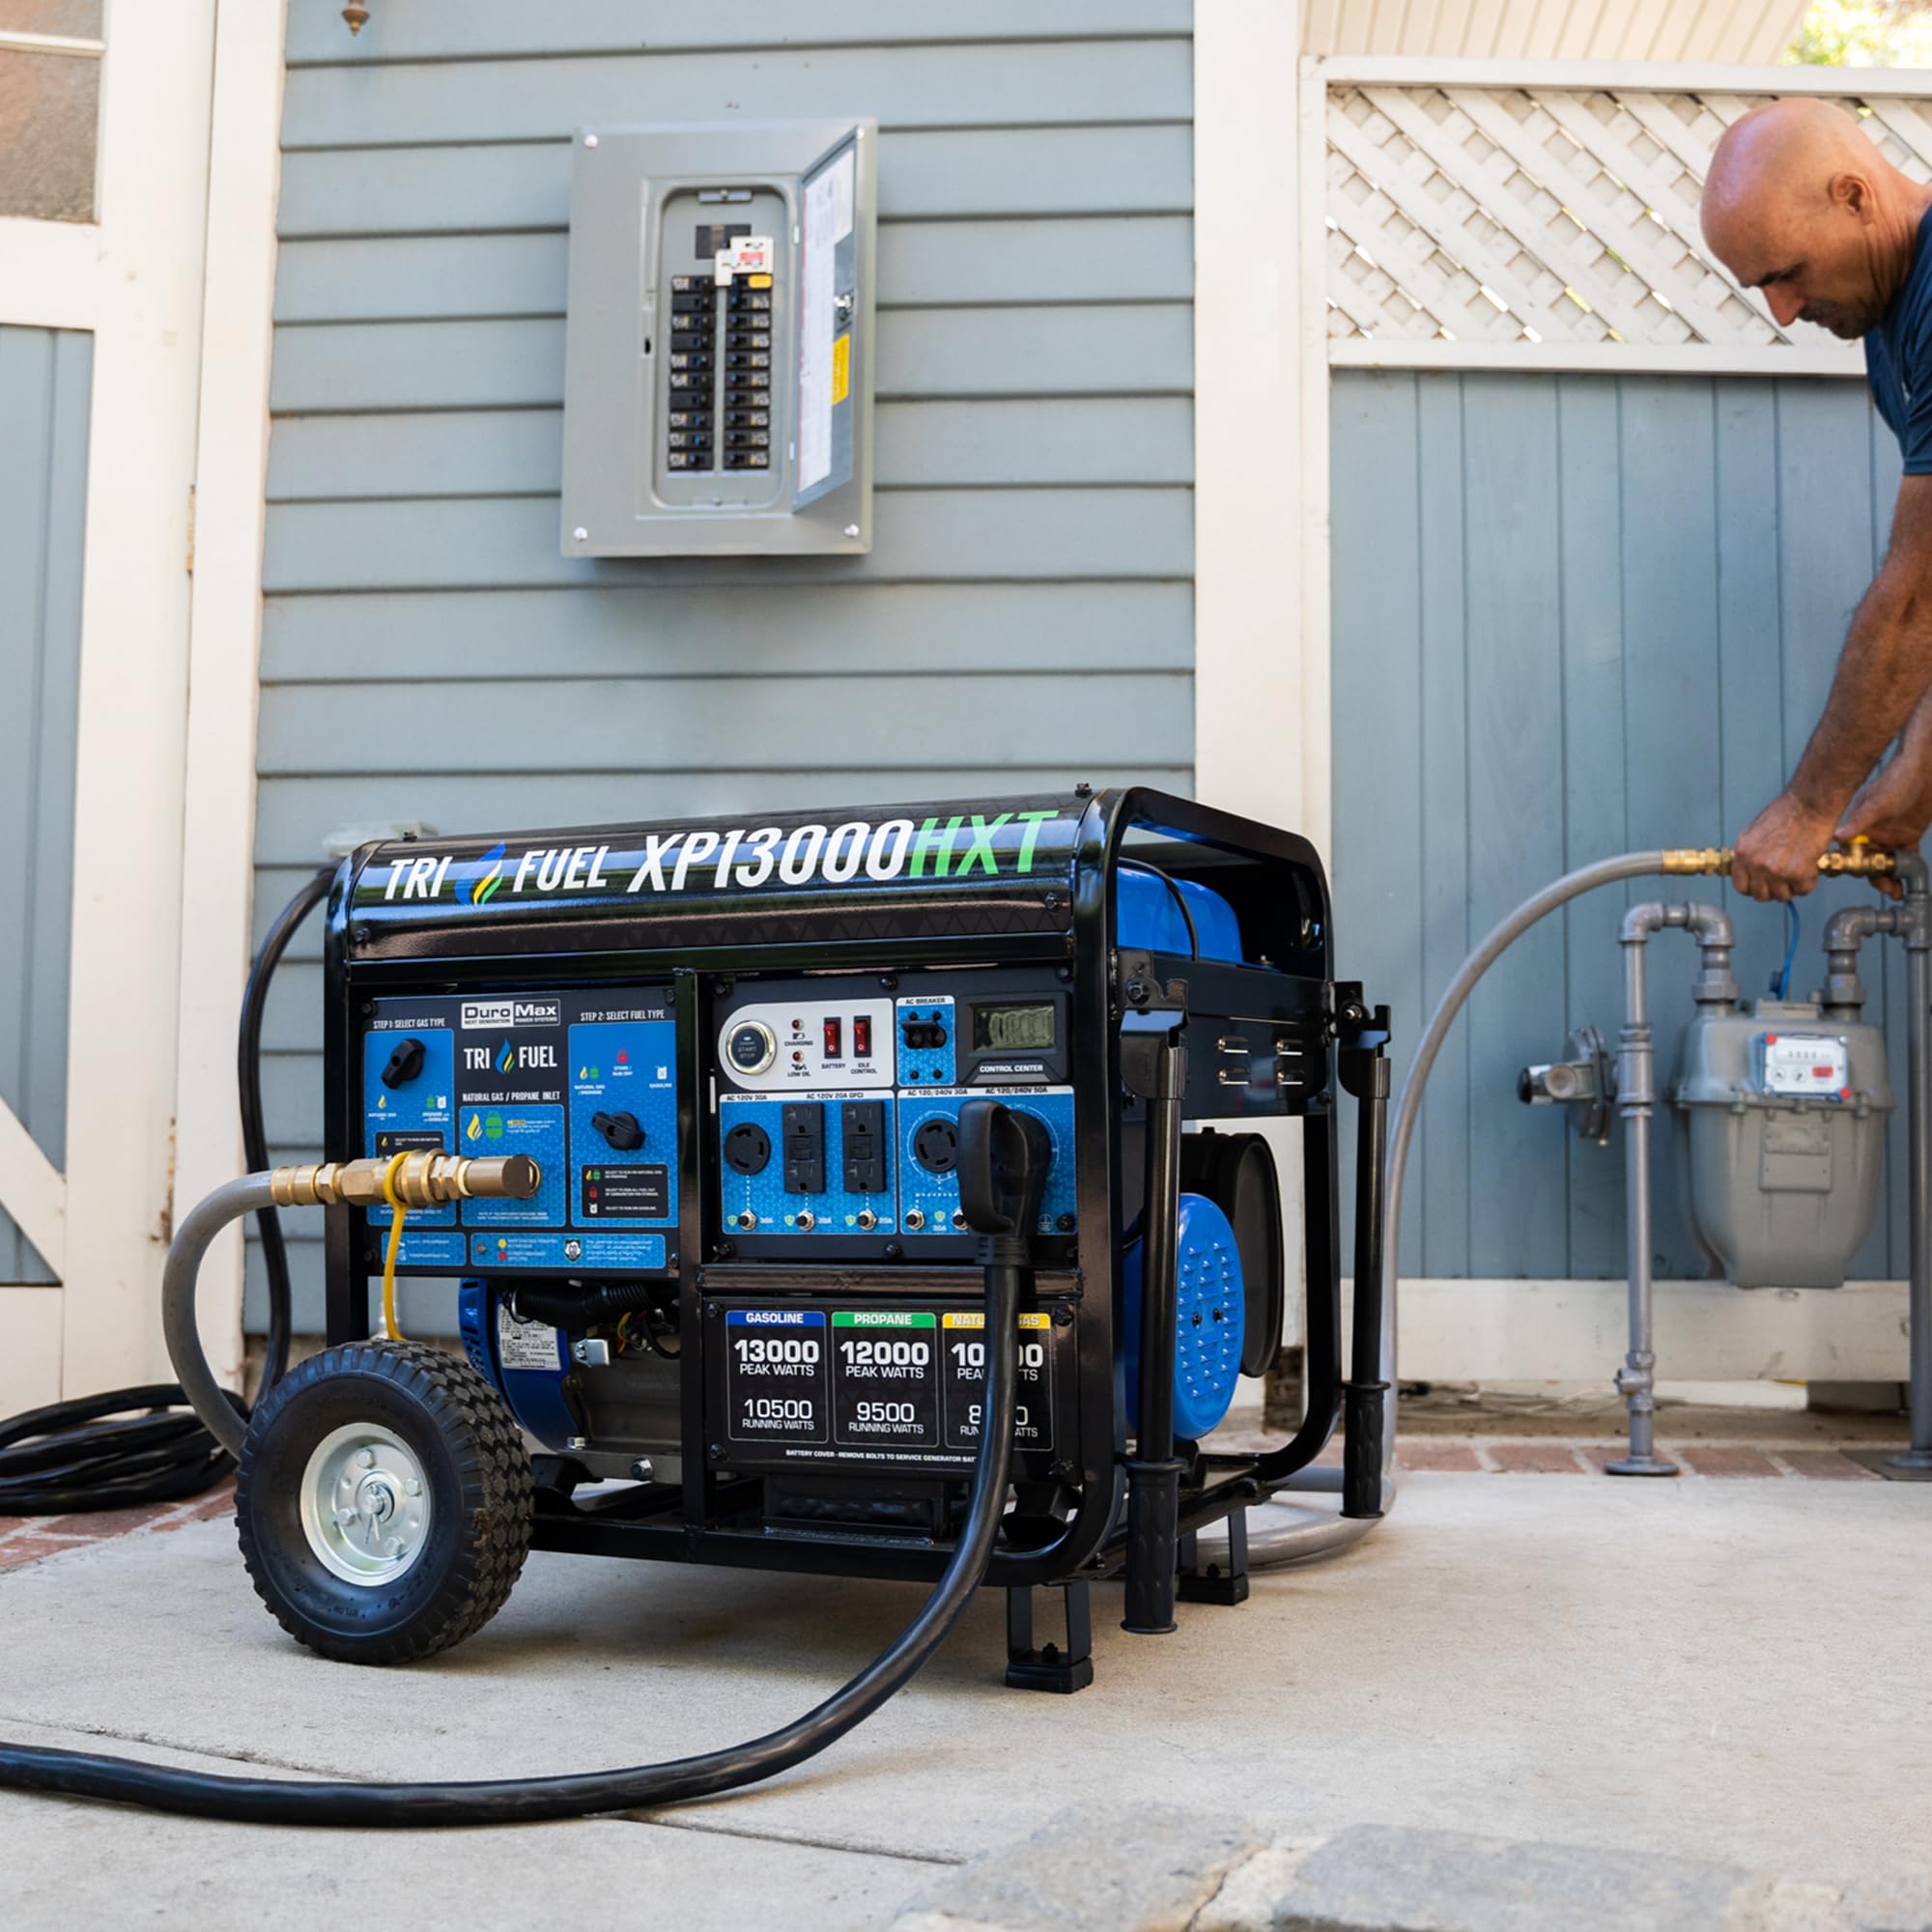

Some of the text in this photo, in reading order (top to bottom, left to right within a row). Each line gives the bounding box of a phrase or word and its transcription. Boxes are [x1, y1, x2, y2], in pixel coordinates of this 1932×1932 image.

[384, 856, 453, 899] TRI
[513, 845, 610, 894] FUEL
[581, 1012, 597, 1021] STEP
[606, 1010, 629, 1020] SELECT
[630, 1009, 646, 1019] FUEL
[647, 1009, 665, 1019] TYPE
[373, 1020, 387, 1029] STEP
[394, 1019, 415, 1028] SELECT
[416, 1018, 429, 1028] GAS
[430, 1018, 445, 1027] TYPE
[464, 1045, 557, 1069] TRI FUEL
[463, 1093, 490, 1101] NATURAL
[491, 1093, 504, 1101] GAS
[511, 1092, 540, 1100] PROPANE
[542, 1091, 560, 1100] INLET
[746, 1313, 804, 1323] GASOLINE
[854, 1314, 912, 1324] PROPANE
[734, 1339, 819, 1363] 13000
[839, 1341, 929, 1366] 12000
[739, 1363, 814, 1377] PEAK WATTS
[846, 1366, 924, 1378] PEAK WATTS
[957, 1368, 983, 1379] PEA
[744, 1399, 812, 1419] 10500
[857, 1402, 914, 1422] 9500
[742, 1419, 814, 1431] RUNNING WATTS
[848, 1422, 923, 1435] RUNNING WATTS
[1014, 1427, 1038, 1437] ATTS
[923, 1454, 961, 1463] GENERATOR
